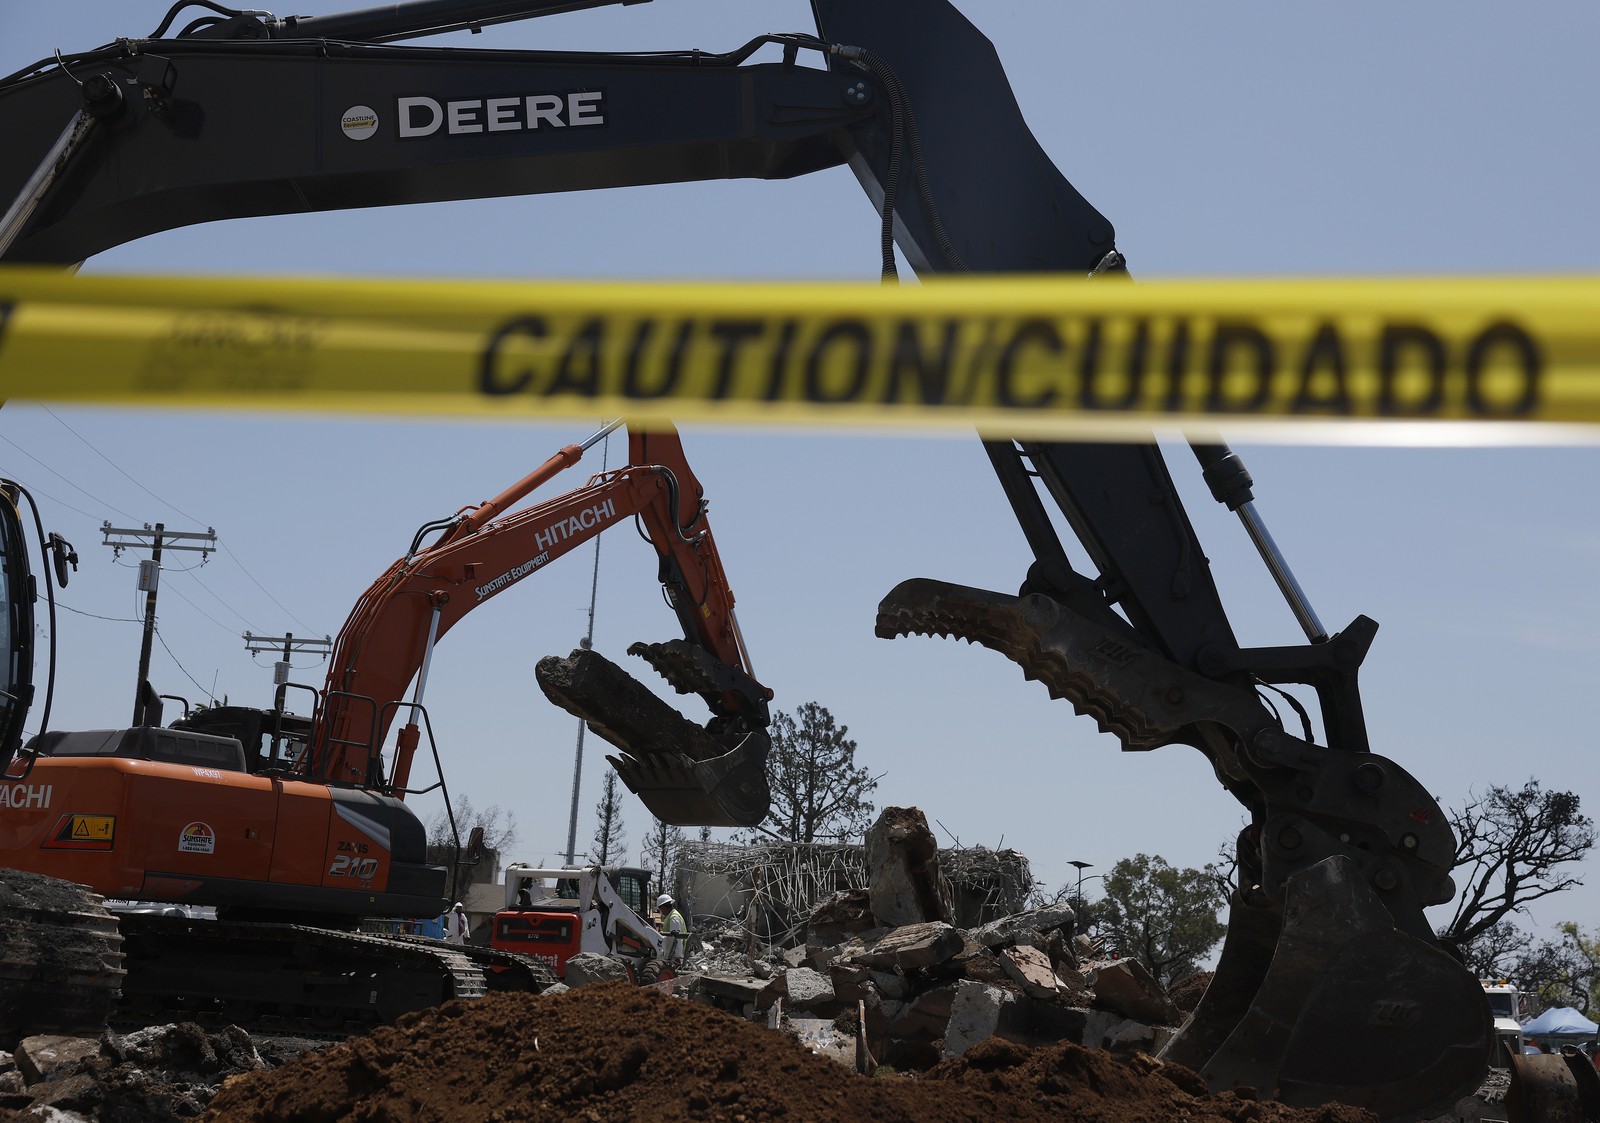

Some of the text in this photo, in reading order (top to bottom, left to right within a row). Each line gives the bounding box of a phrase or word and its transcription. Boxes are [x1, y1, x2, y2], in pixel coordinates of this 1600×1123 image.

[342, 115, 375, 123] COASTLINE
[397, 91, 603, 138] DEERE
[534, 498, 617, 551] HITACHI
[0, 784, 53, 808] ACHI
[337, 841, 369, 854] ZAXIS
[329, 854, 379, 879] 210
